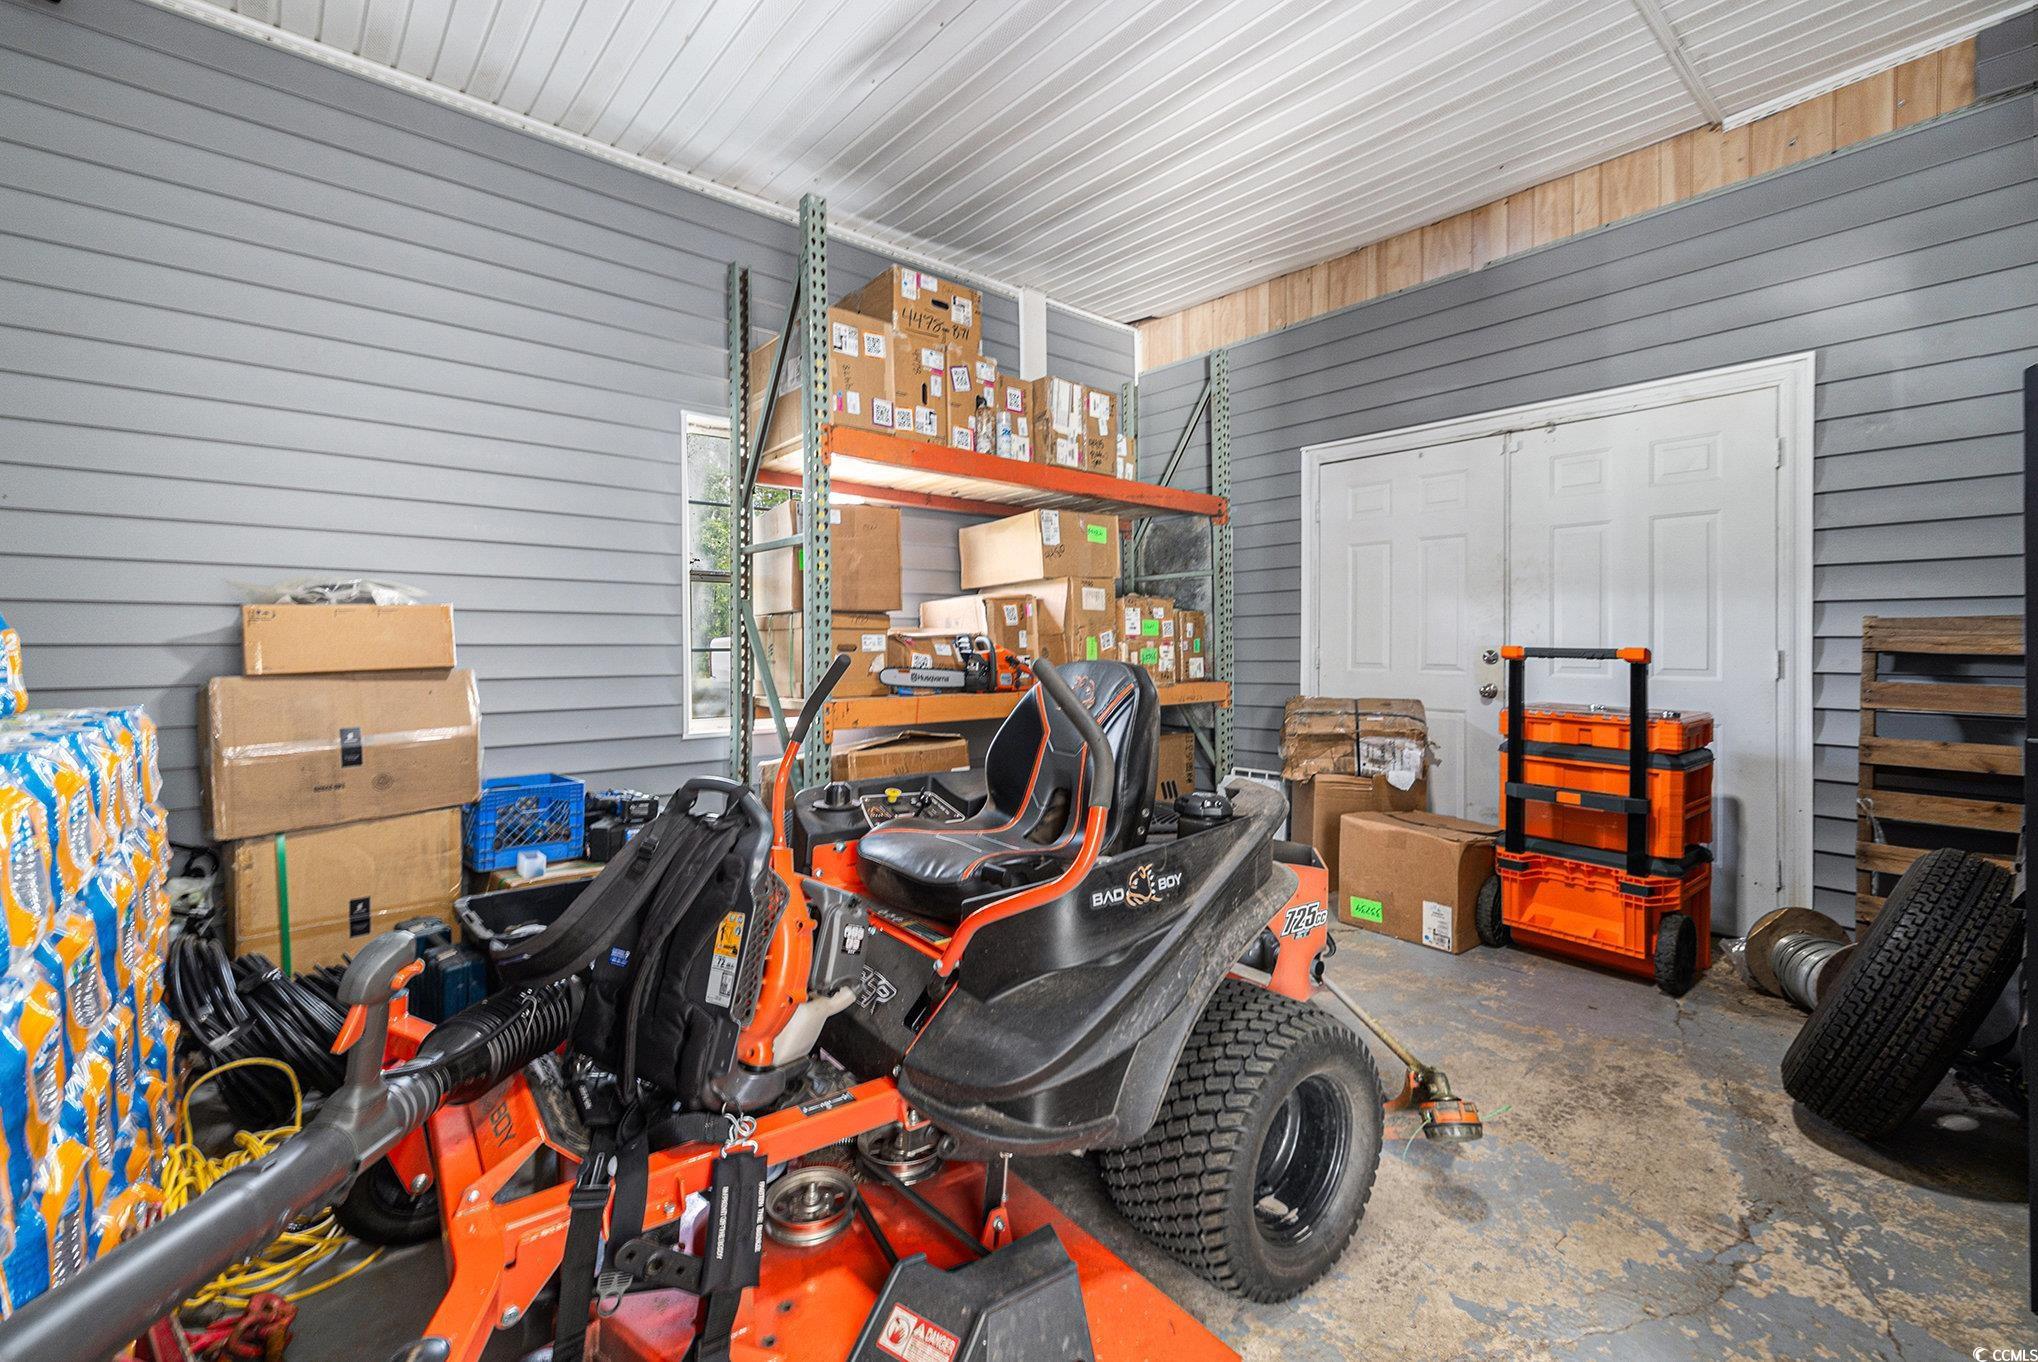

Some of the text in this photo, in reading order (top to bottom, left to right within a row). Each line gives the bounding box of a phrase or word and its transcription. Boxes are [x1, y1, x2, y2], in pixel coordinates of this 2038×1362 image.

[1157, 872, 1183, 891] BOY
[1092, 887, 1126, 907] BAD
[490, 1102, 516, 1147] BOY
